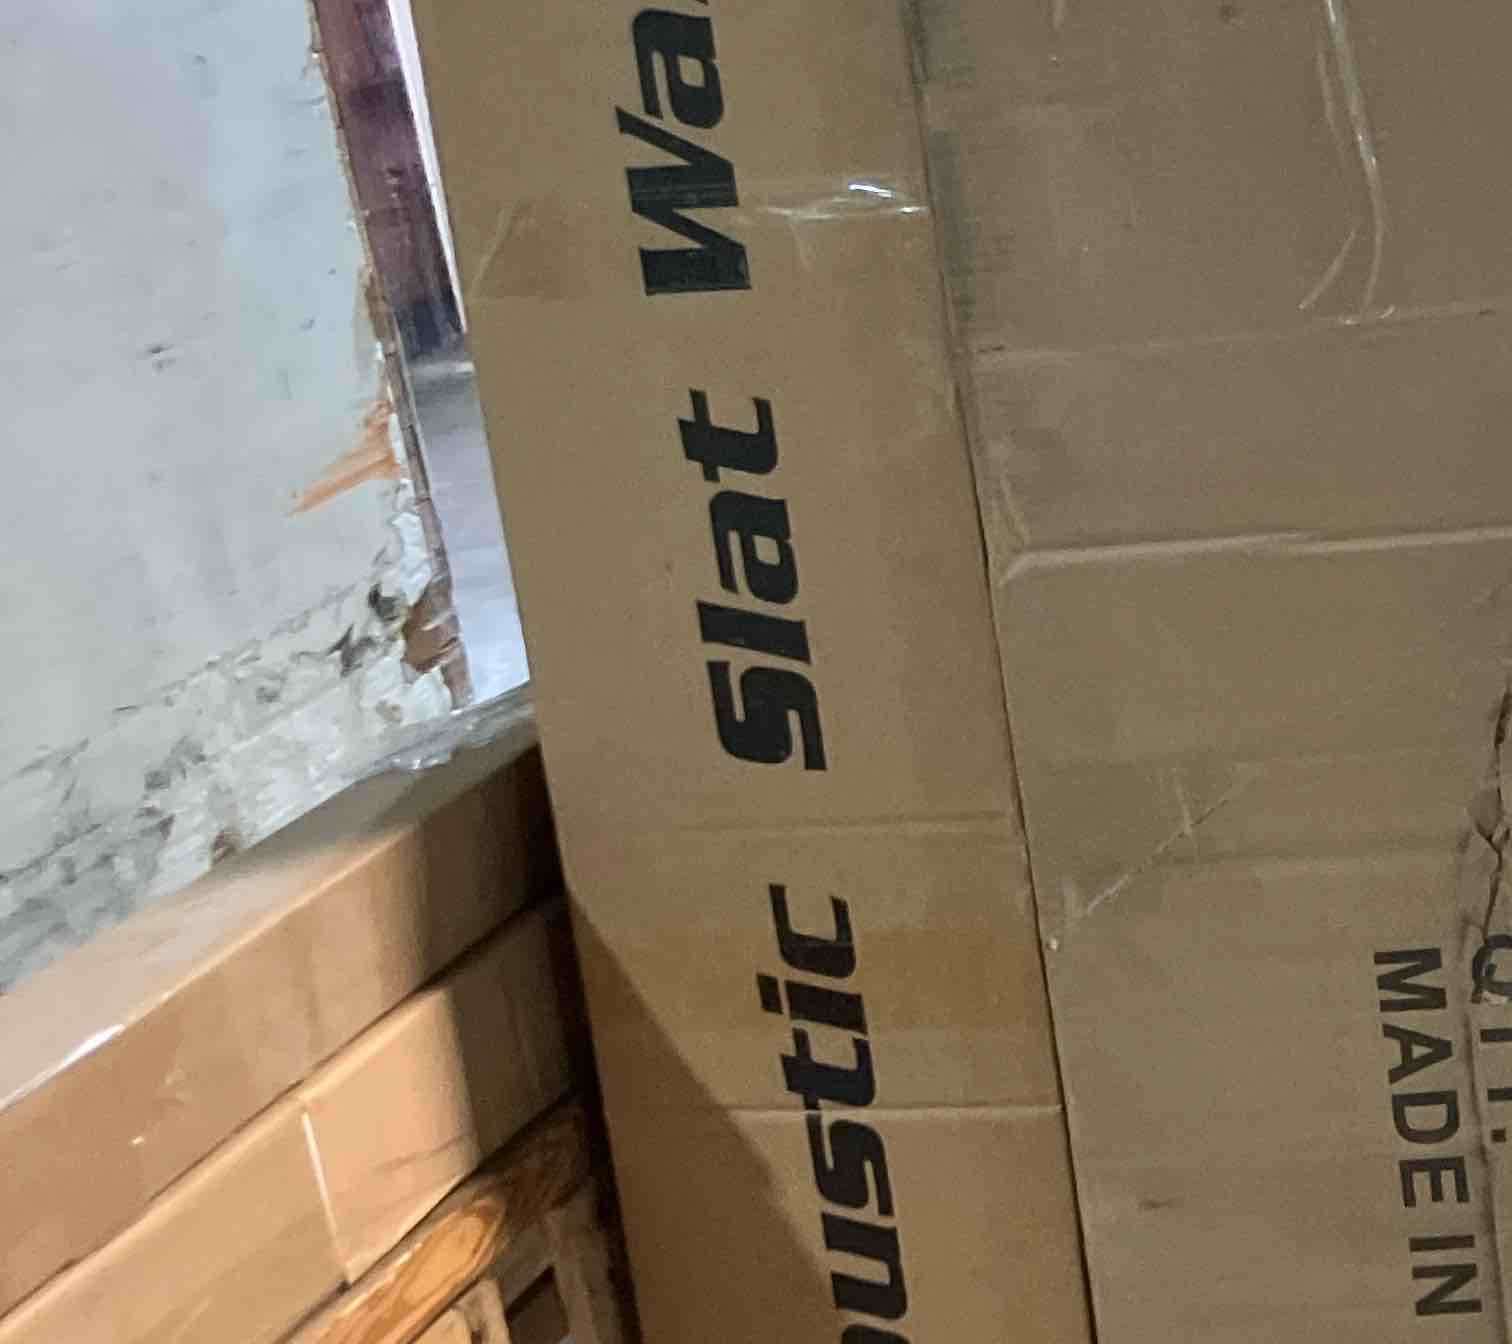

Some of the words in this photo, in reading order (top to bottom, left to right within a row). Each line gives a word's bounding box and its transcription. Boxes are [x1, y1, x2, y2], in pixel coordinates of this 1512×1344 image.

[676, 387, 829, 773] Slat
[1373, 947, 1471, 1208] MADE
[1410, 1234, 1483, 1318] IN
